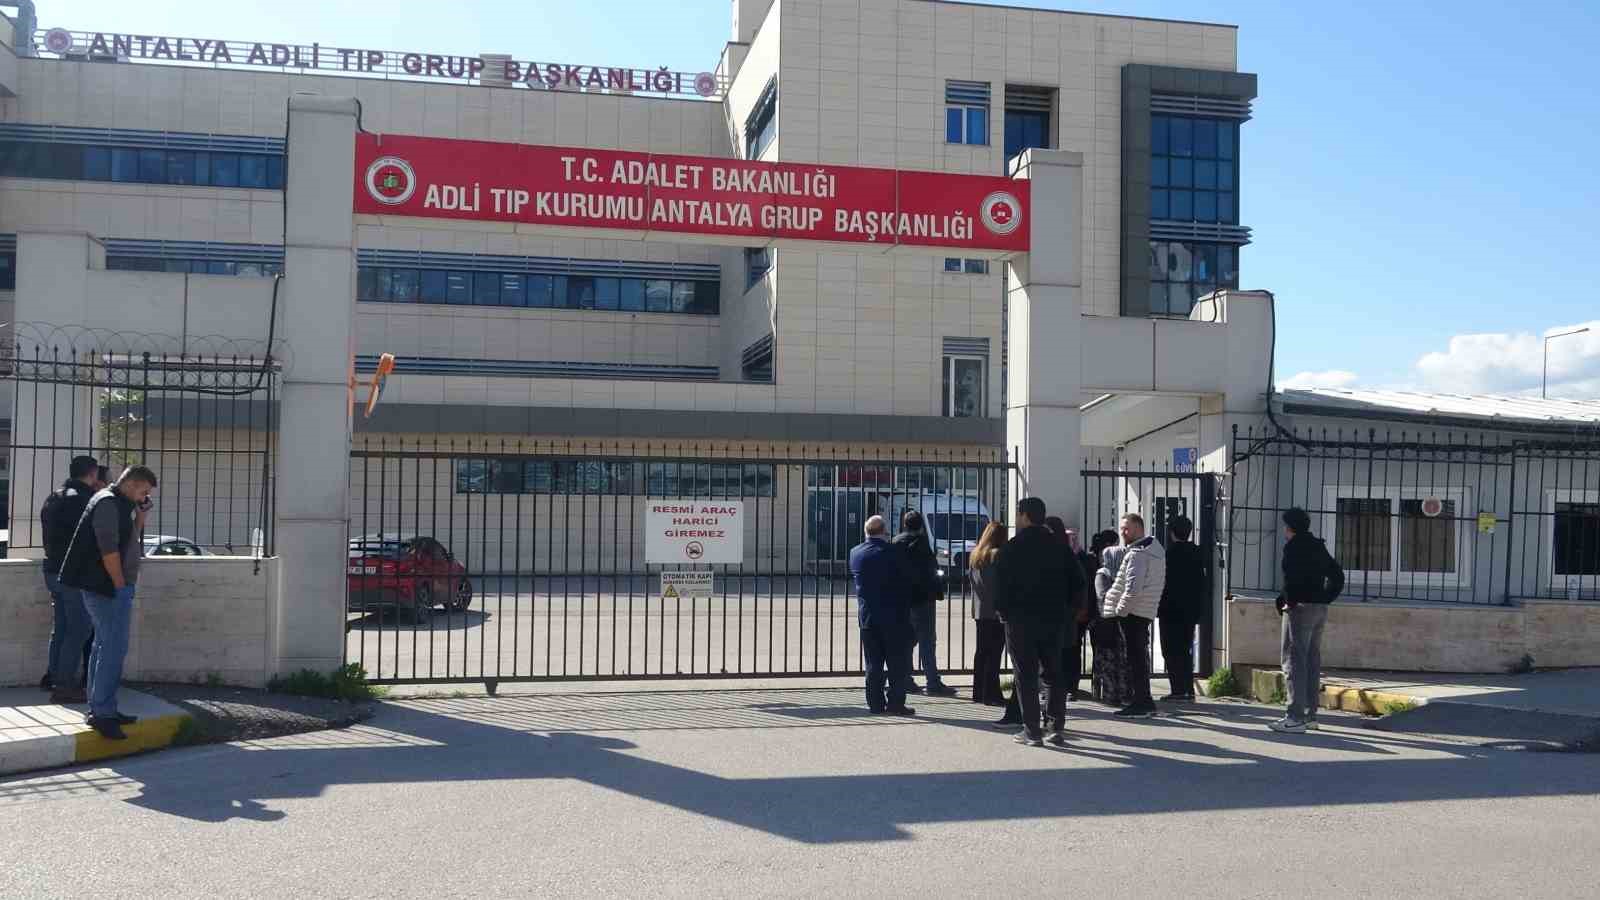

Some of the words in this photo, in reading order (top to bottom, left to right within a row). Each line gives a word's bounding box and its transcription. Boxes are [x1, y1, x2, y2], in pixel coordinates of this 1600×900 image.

[88, 32, 232, 63] ANTALYA
[248, 43, 319, 68] ADLİ
[337, 48, 384, 71] TIP
[402, 53, 484, 78] GRUP
[504, 60, 681, 93] BAŞKANLIĞI
[561, 156, 603, 182] T.C.
[611, 160, 703, 188] ADALET
[712, 167, 835, 197] BAKANLIĞI
[424, 183, 480, 212] ADLİ
[490, 189, 529, 214] TIP
[536, 192, 644, 221] KURUMU
[651, 199, 753, 226] ANTALYA
[761, 204, 822, 230] GRUP
[834, 209, 973, 240] BAŞKANLIĞI
[653, 504, 694, 513] RESMİ
[700, 506, 737, 517] ARAÇ
[664, 529, 725, 537] GİREMEZ
